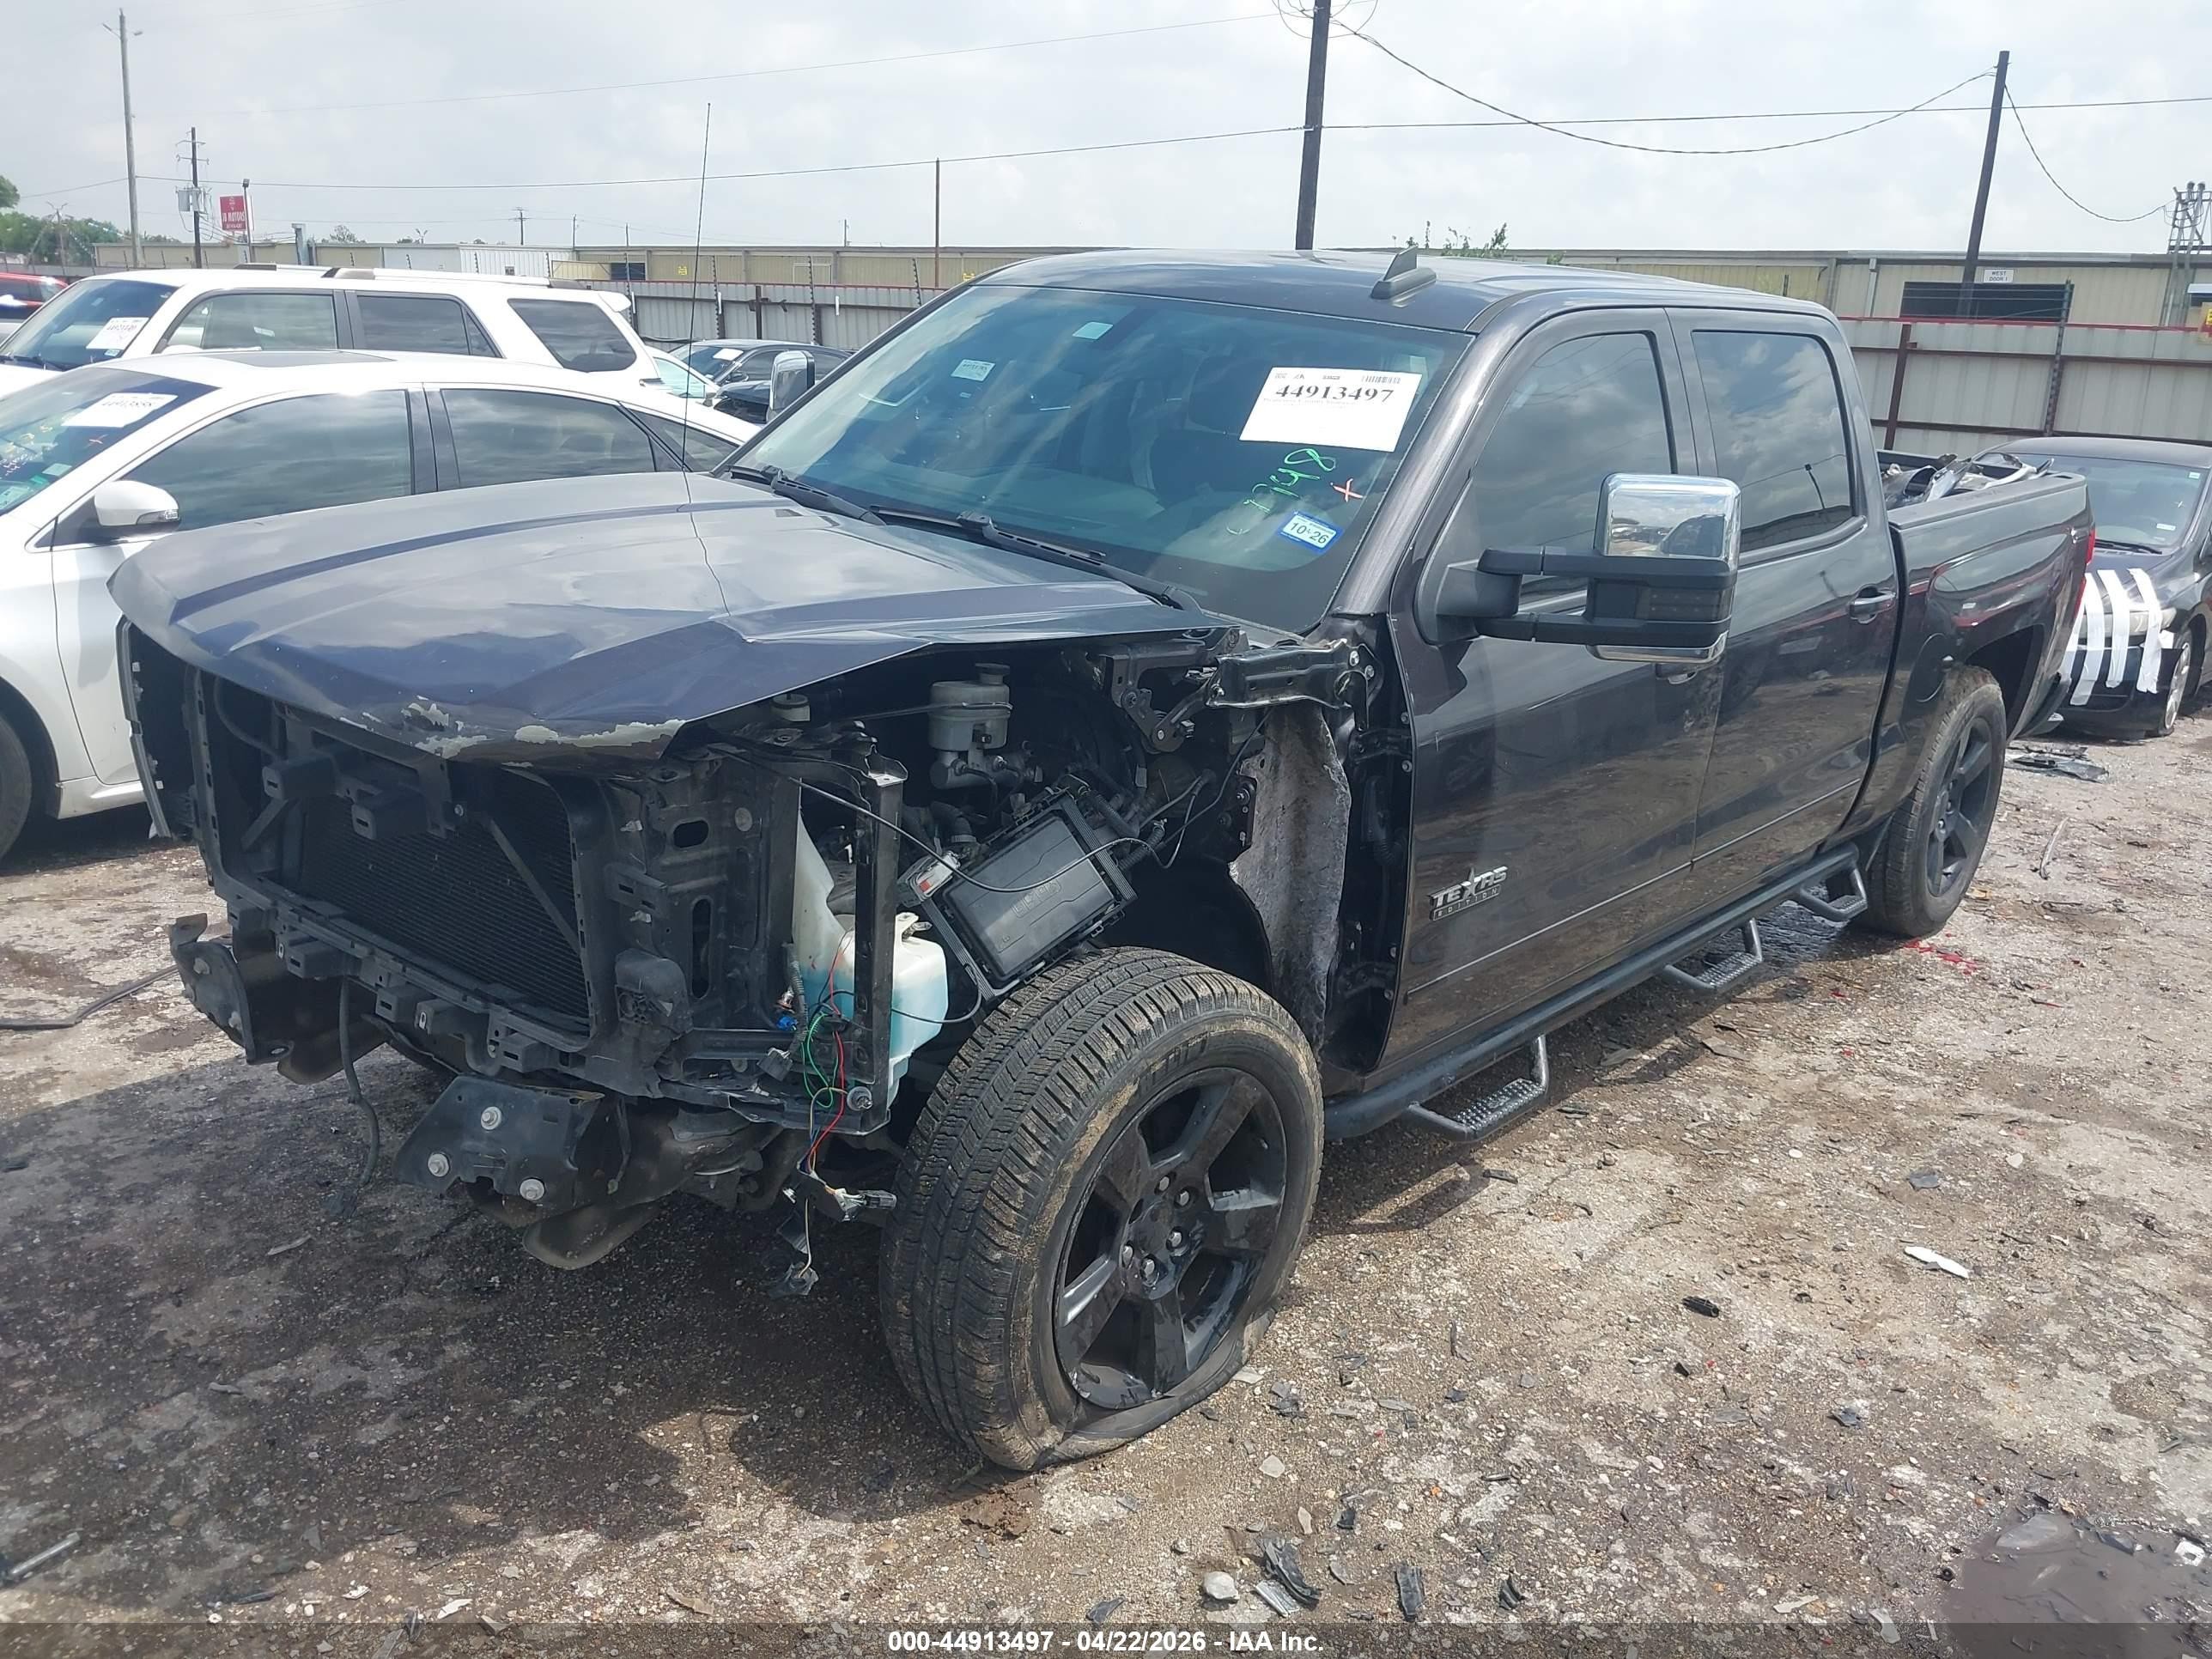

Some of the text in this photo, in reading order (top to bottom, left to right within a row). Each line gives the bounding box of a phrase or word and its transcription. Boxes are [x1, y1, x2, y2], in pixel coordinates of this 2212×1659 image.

[228, 210, 246, 222] MOTORS
[1275, 384, 1395, 403] 44913497
[1429, 866, 1509, 908] TEXAS
[1437, 888, 1498, 918] EDITION
